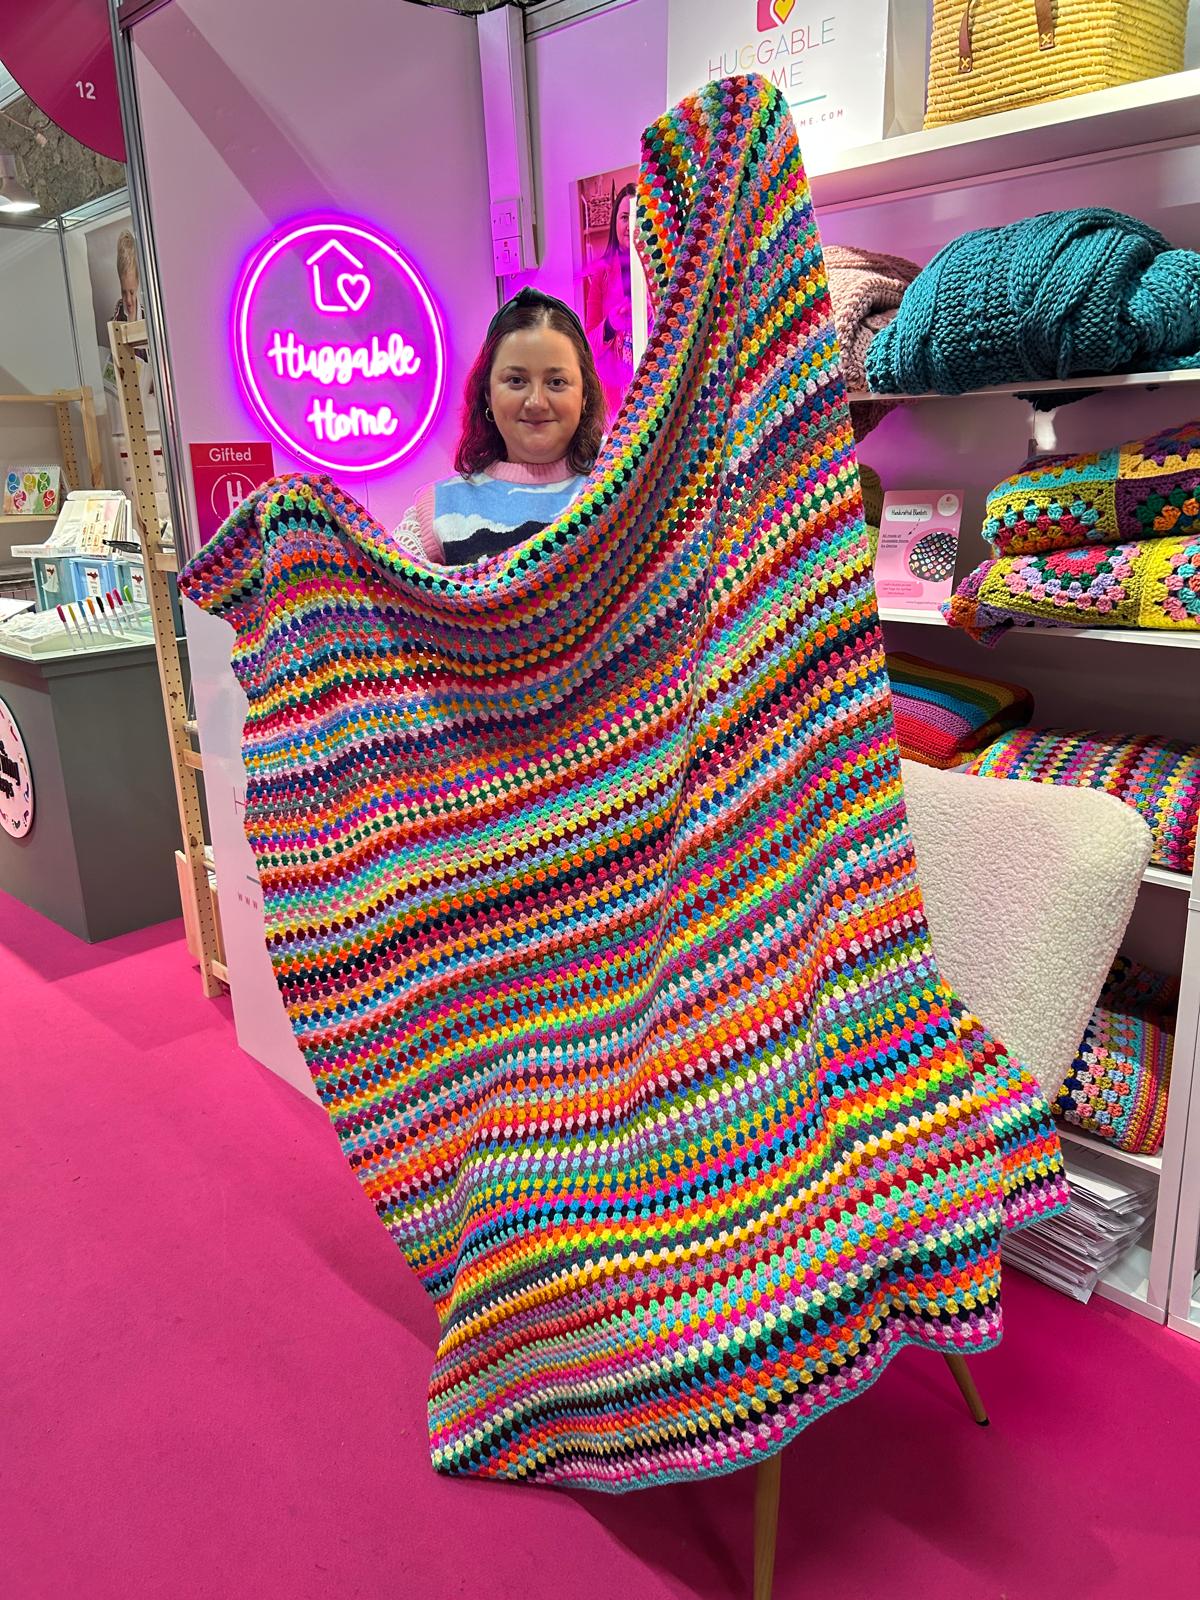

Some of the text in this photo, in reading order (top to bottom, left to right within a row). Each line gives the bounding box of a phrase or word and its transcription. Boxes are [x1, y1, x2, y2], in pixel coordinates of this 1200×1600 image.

[708, 16, 836, 81] HUGGABLE
[771, 60, 804, 89] ME
[75, 80, 97, 100] 12
[800, 109, 844, 127] ME.COM
[267, 332, 421, 384] Huggable
[307, 398, 399, 442] Home
[208, 447, 252, 462] Gifted
